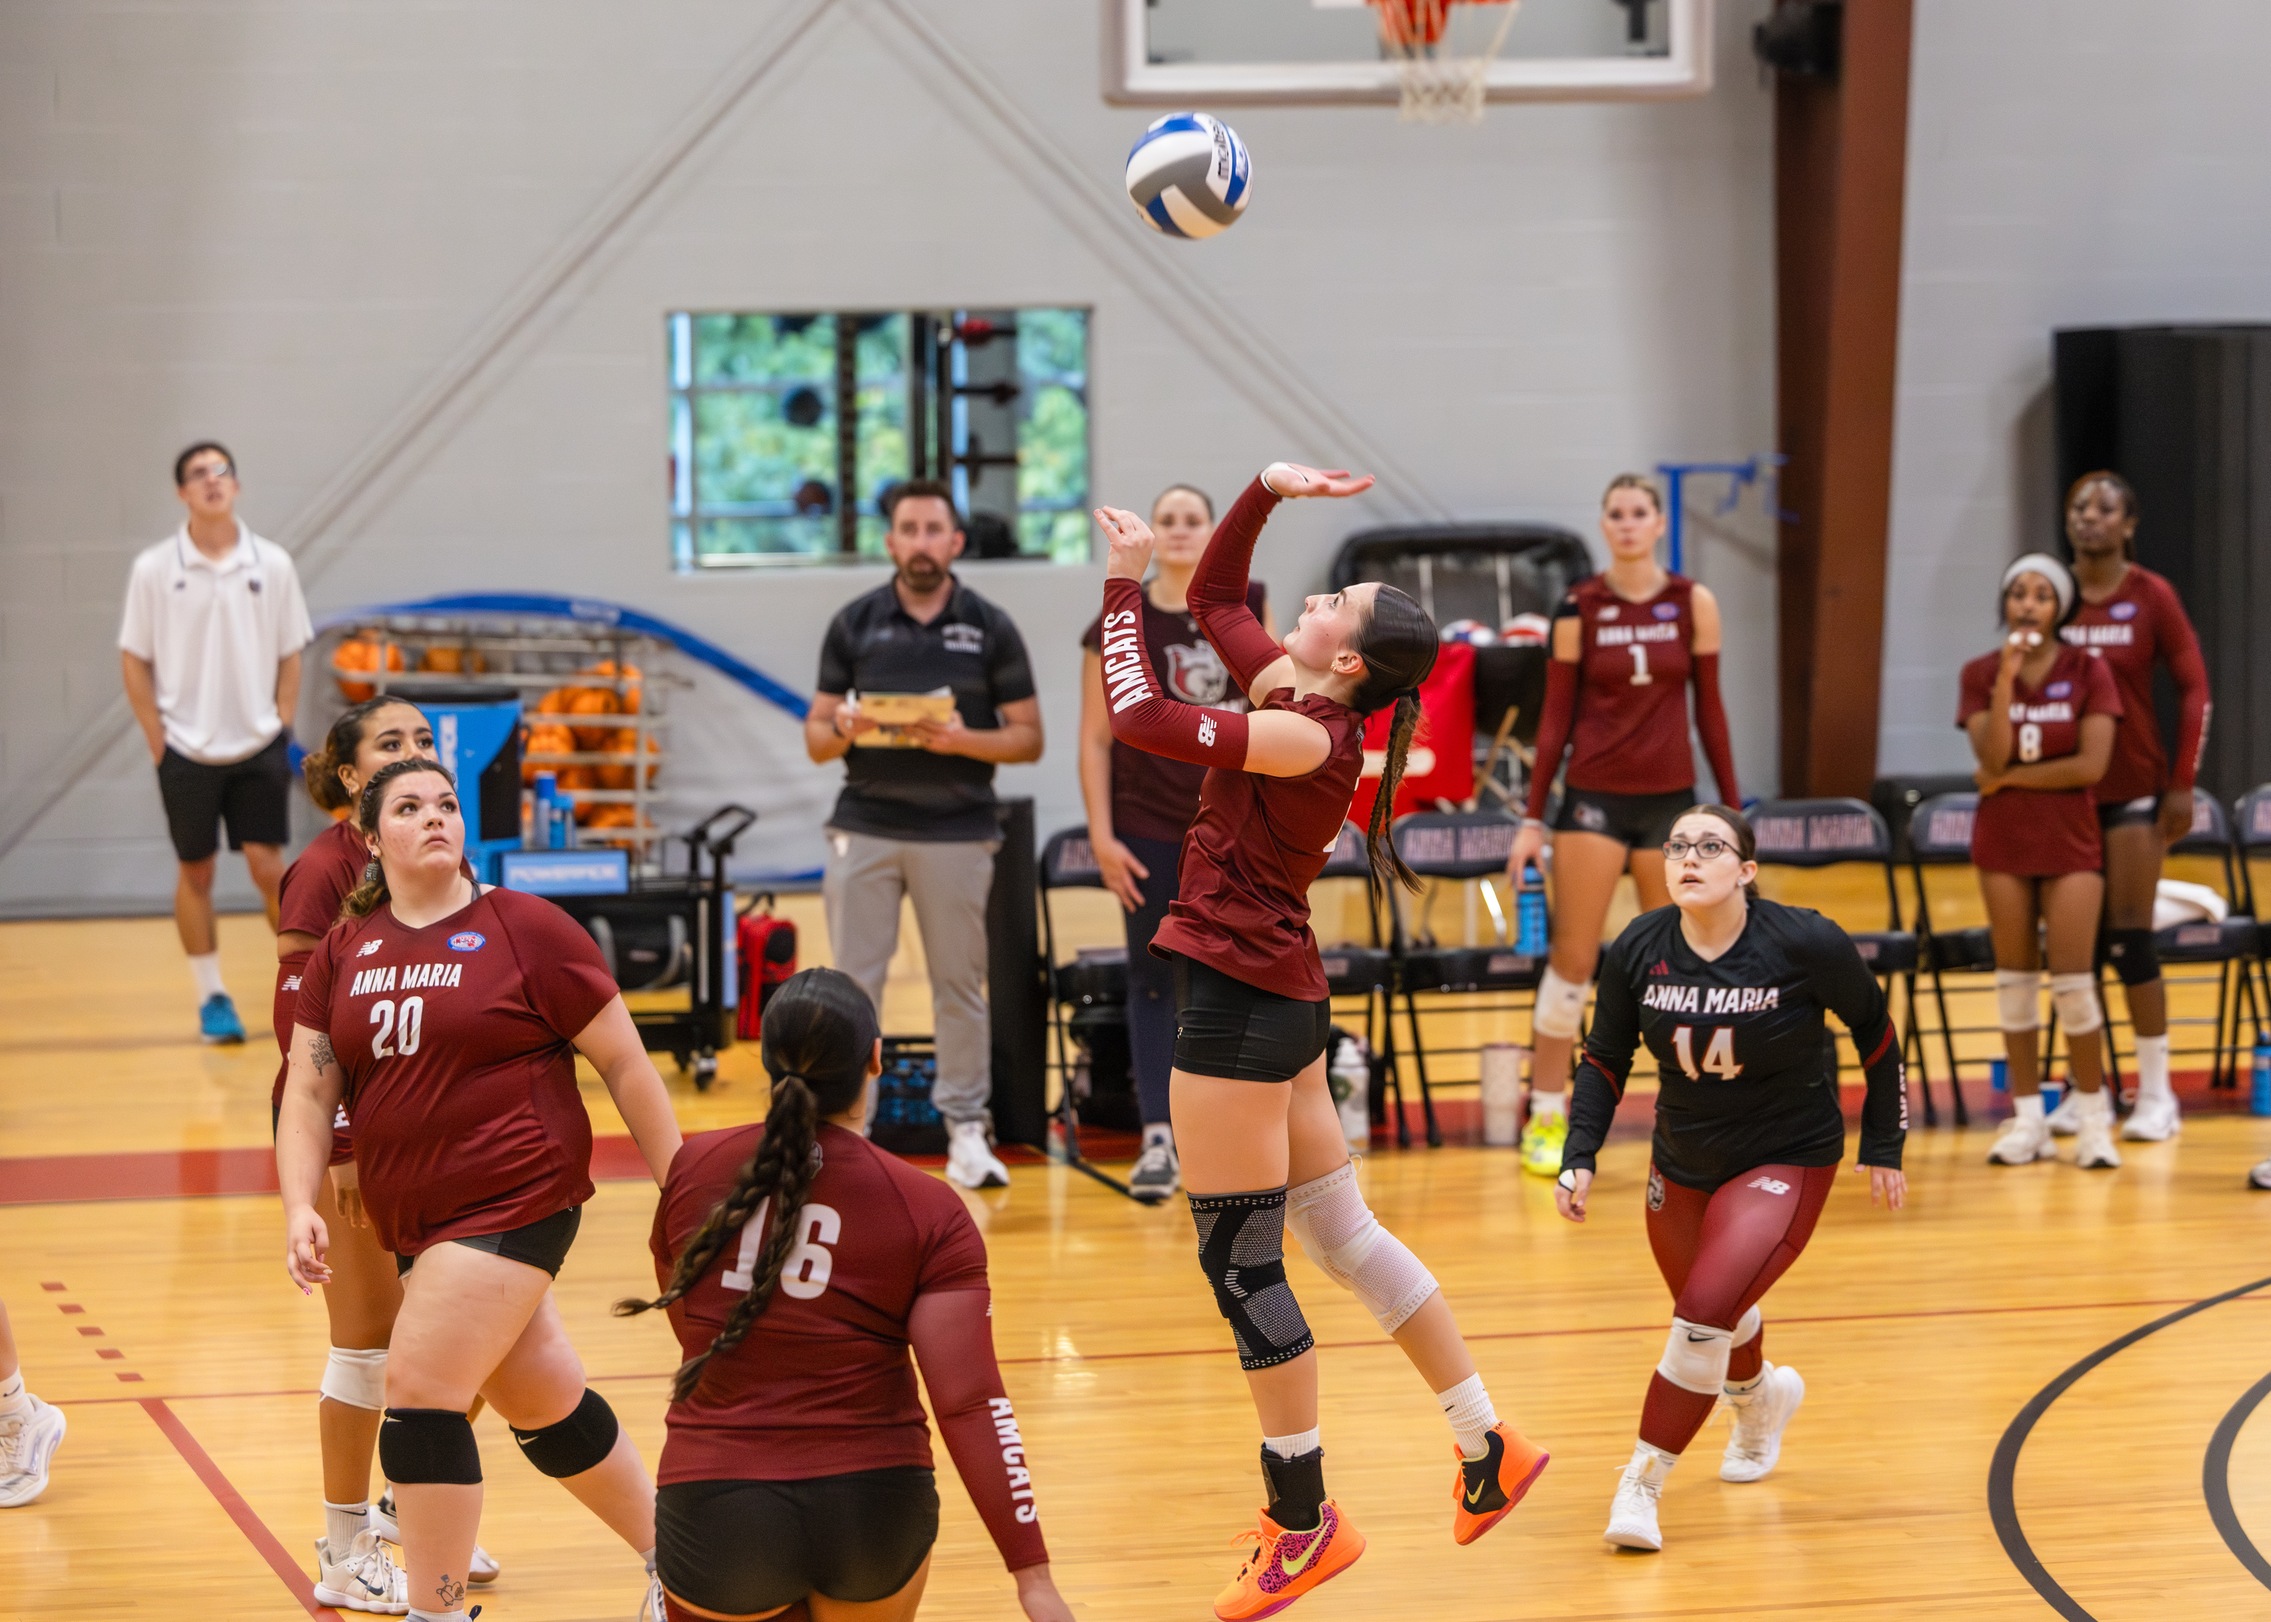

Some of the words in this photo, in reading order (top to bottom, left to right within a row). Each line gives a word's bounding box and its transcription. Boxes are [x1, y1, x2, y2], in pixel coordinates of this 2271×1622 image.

[1104, 610, 1153, 714] AMCATS
[1627, 643, 1653, 686] 1
[2018, 722, 2042, 763] 8
[350, 966, 397, 997] ANNA
[400, 963, 463, 990] MARIA
[1643, 984, 1700, 1013] ANNA
[1703, 987, 1780, 1014] MARIA
[369, 996, 424, 1060] 20
[1671, 1024, 1745, 1082] 14
[721, 1195, 841, 1299] 16
[988, 1397, 1039, 1524] AMCATS
